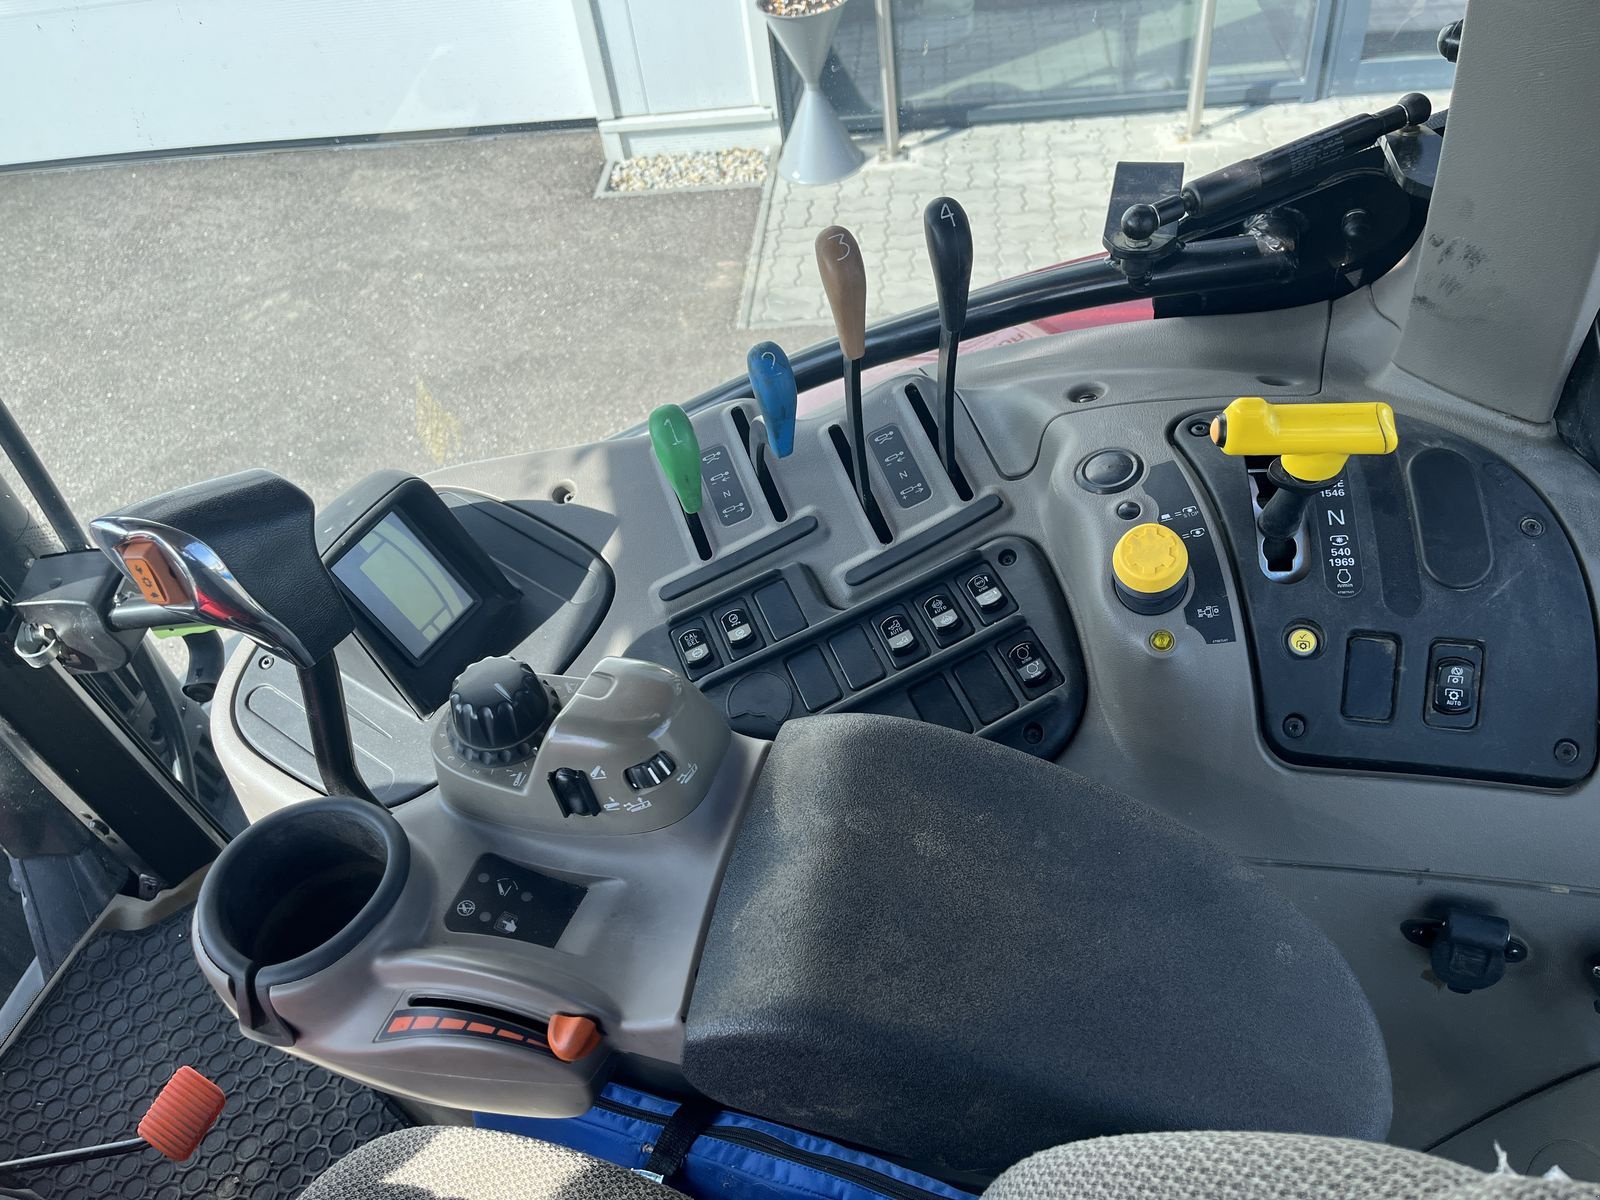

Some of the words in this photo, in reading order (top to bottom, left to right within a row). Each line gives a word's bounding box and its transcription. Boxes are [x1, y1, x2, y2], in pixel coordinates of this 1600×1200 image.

[940, 203, 955, 227] 4
[827, 233, 850, 262] 3
[663, 418, 683, 446] 1
[899, 470, 908, 480] N
[722, 489, 731, 499] N
[1320, 488, 1345, 498] 1546
[1327, 509, 1345, 526] N
[1330, 547, 1351, 557] 540
[1328, 557, 1355, 567] 1969
[684, 632, 698, 641] CAL
[889, 626, 904, 637] AUTO
[1446, 699, 1462, 707] AUTO
